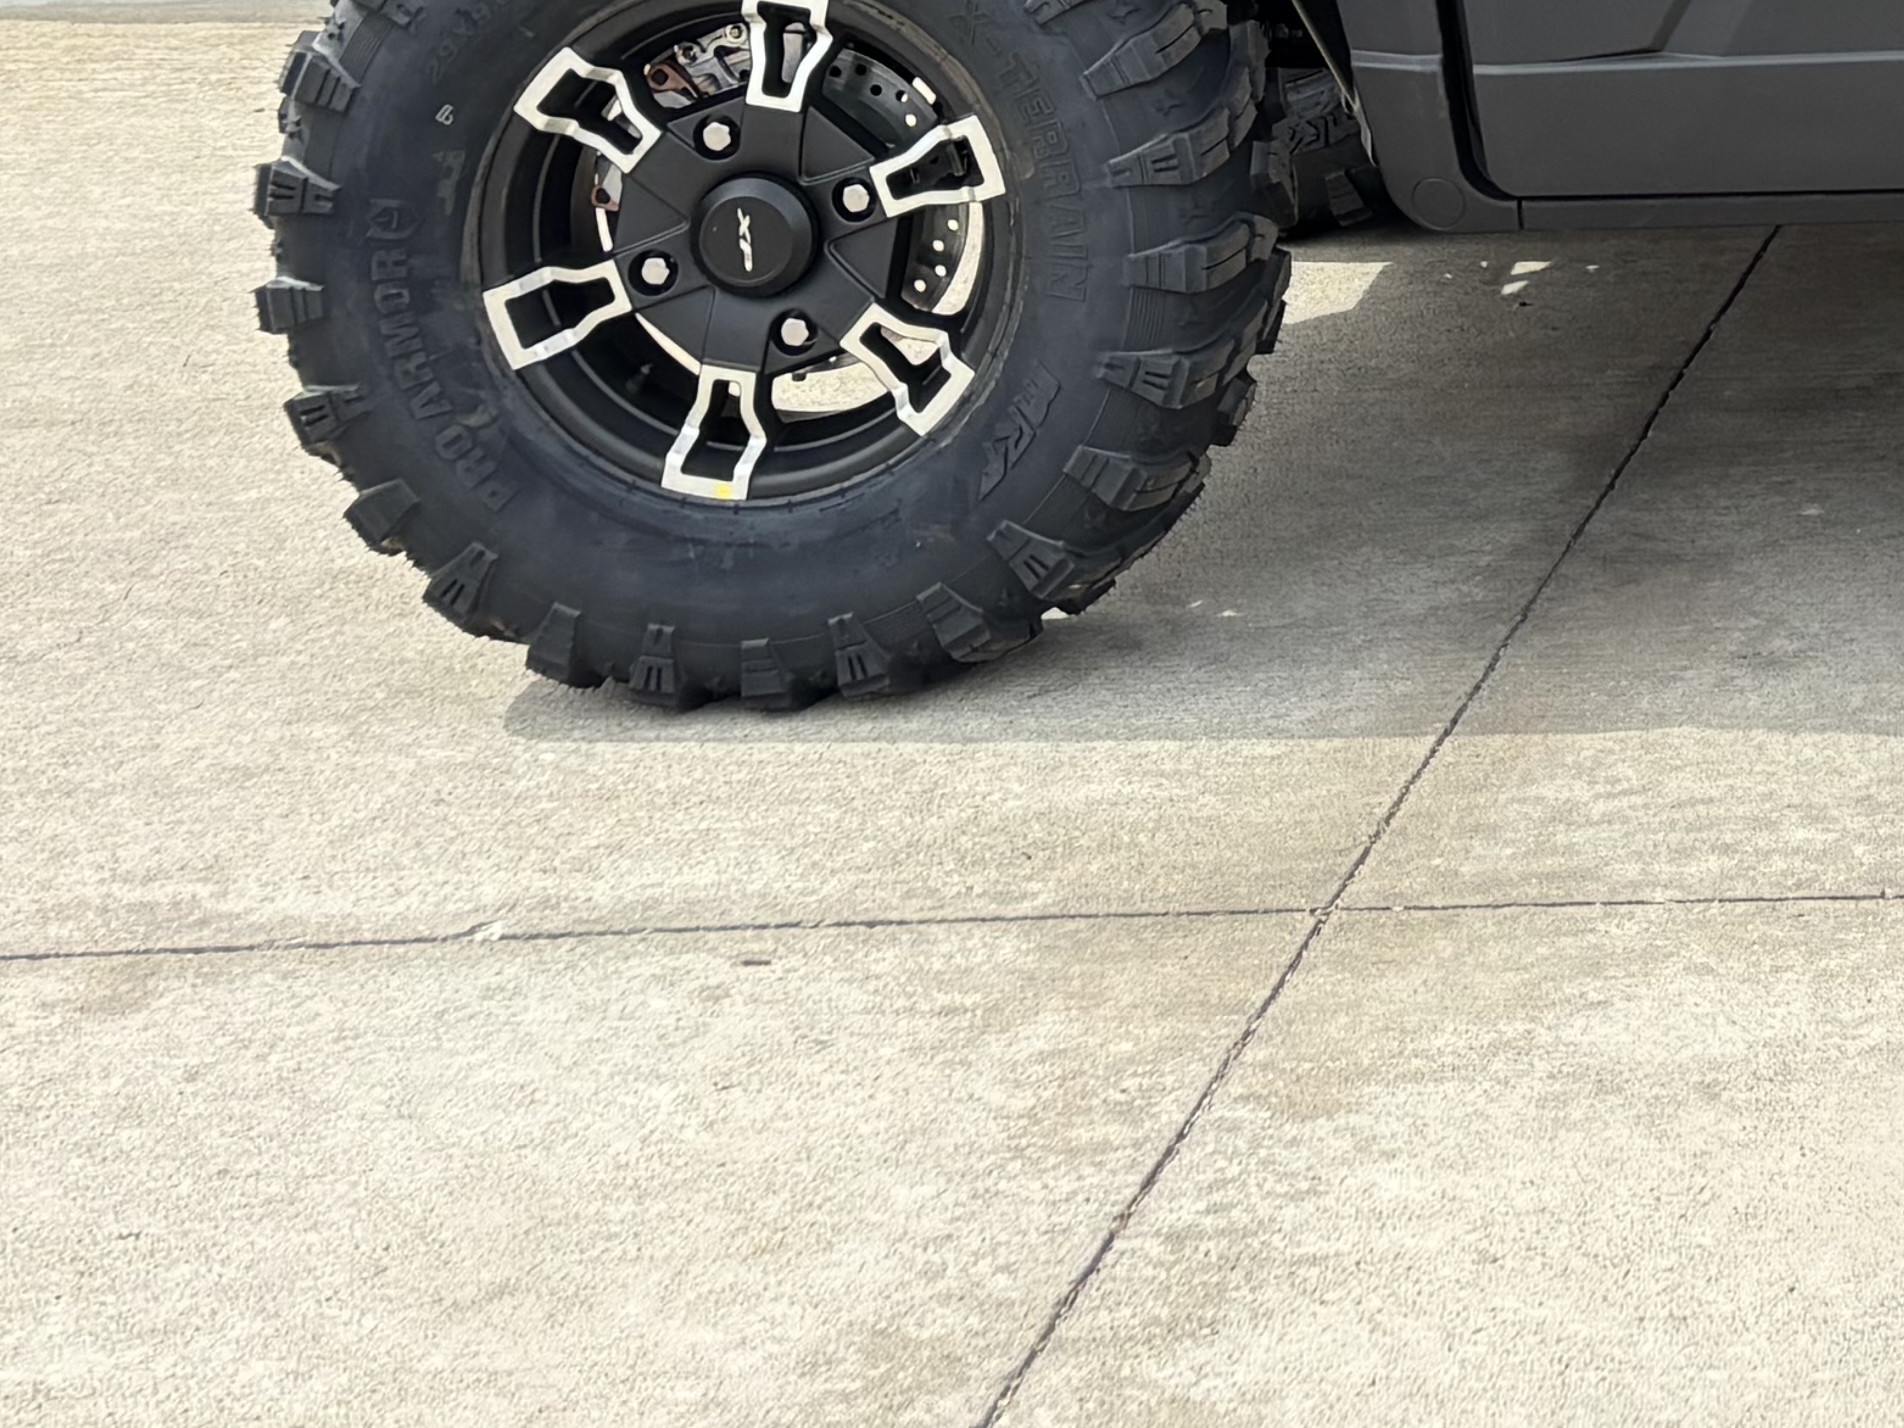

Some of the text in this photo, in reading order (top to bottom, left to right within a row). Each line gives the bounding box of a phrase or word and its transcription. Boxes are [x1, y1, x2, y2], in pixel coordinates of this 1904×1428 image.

[736, 207, 753, 272] XP
[371, 249, 521, 513] PRO ARMOR
